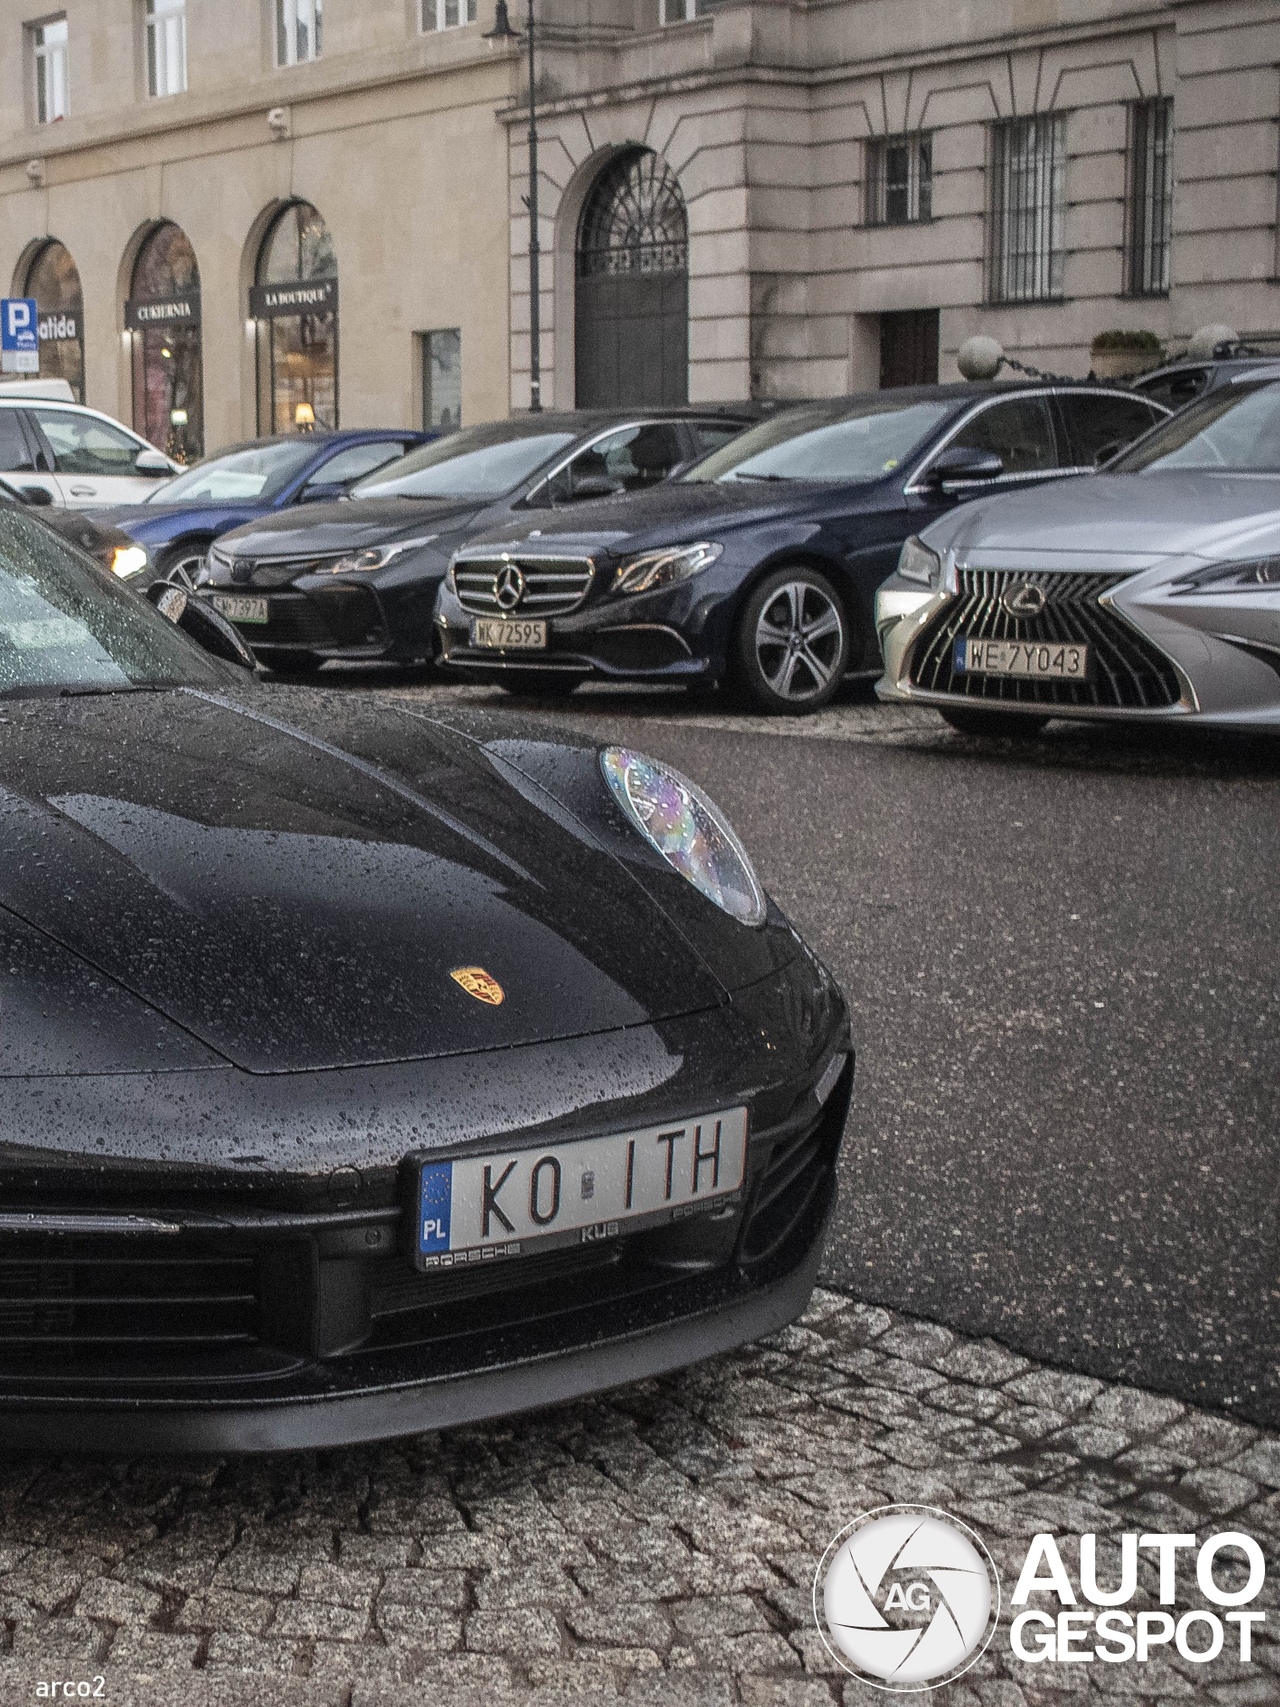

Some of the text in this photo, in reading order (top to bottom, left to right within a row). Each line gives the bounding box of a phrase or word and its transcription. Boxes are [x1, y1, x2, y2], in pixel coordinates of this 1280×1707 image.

[278, 288, 325, 305] BOUTIQUE
[8, 303, 30, 336] P
[138, 302, 191, 321] CUKIERNIA
[37, 314, 76, 340] atida
[497, 623, 542, 643] 72595
[971, 642, 1080, 673] WE 7Y043
[423, 1219, 446, 1241] PL
[425, 1242, 520, 1268] PORSCHE
